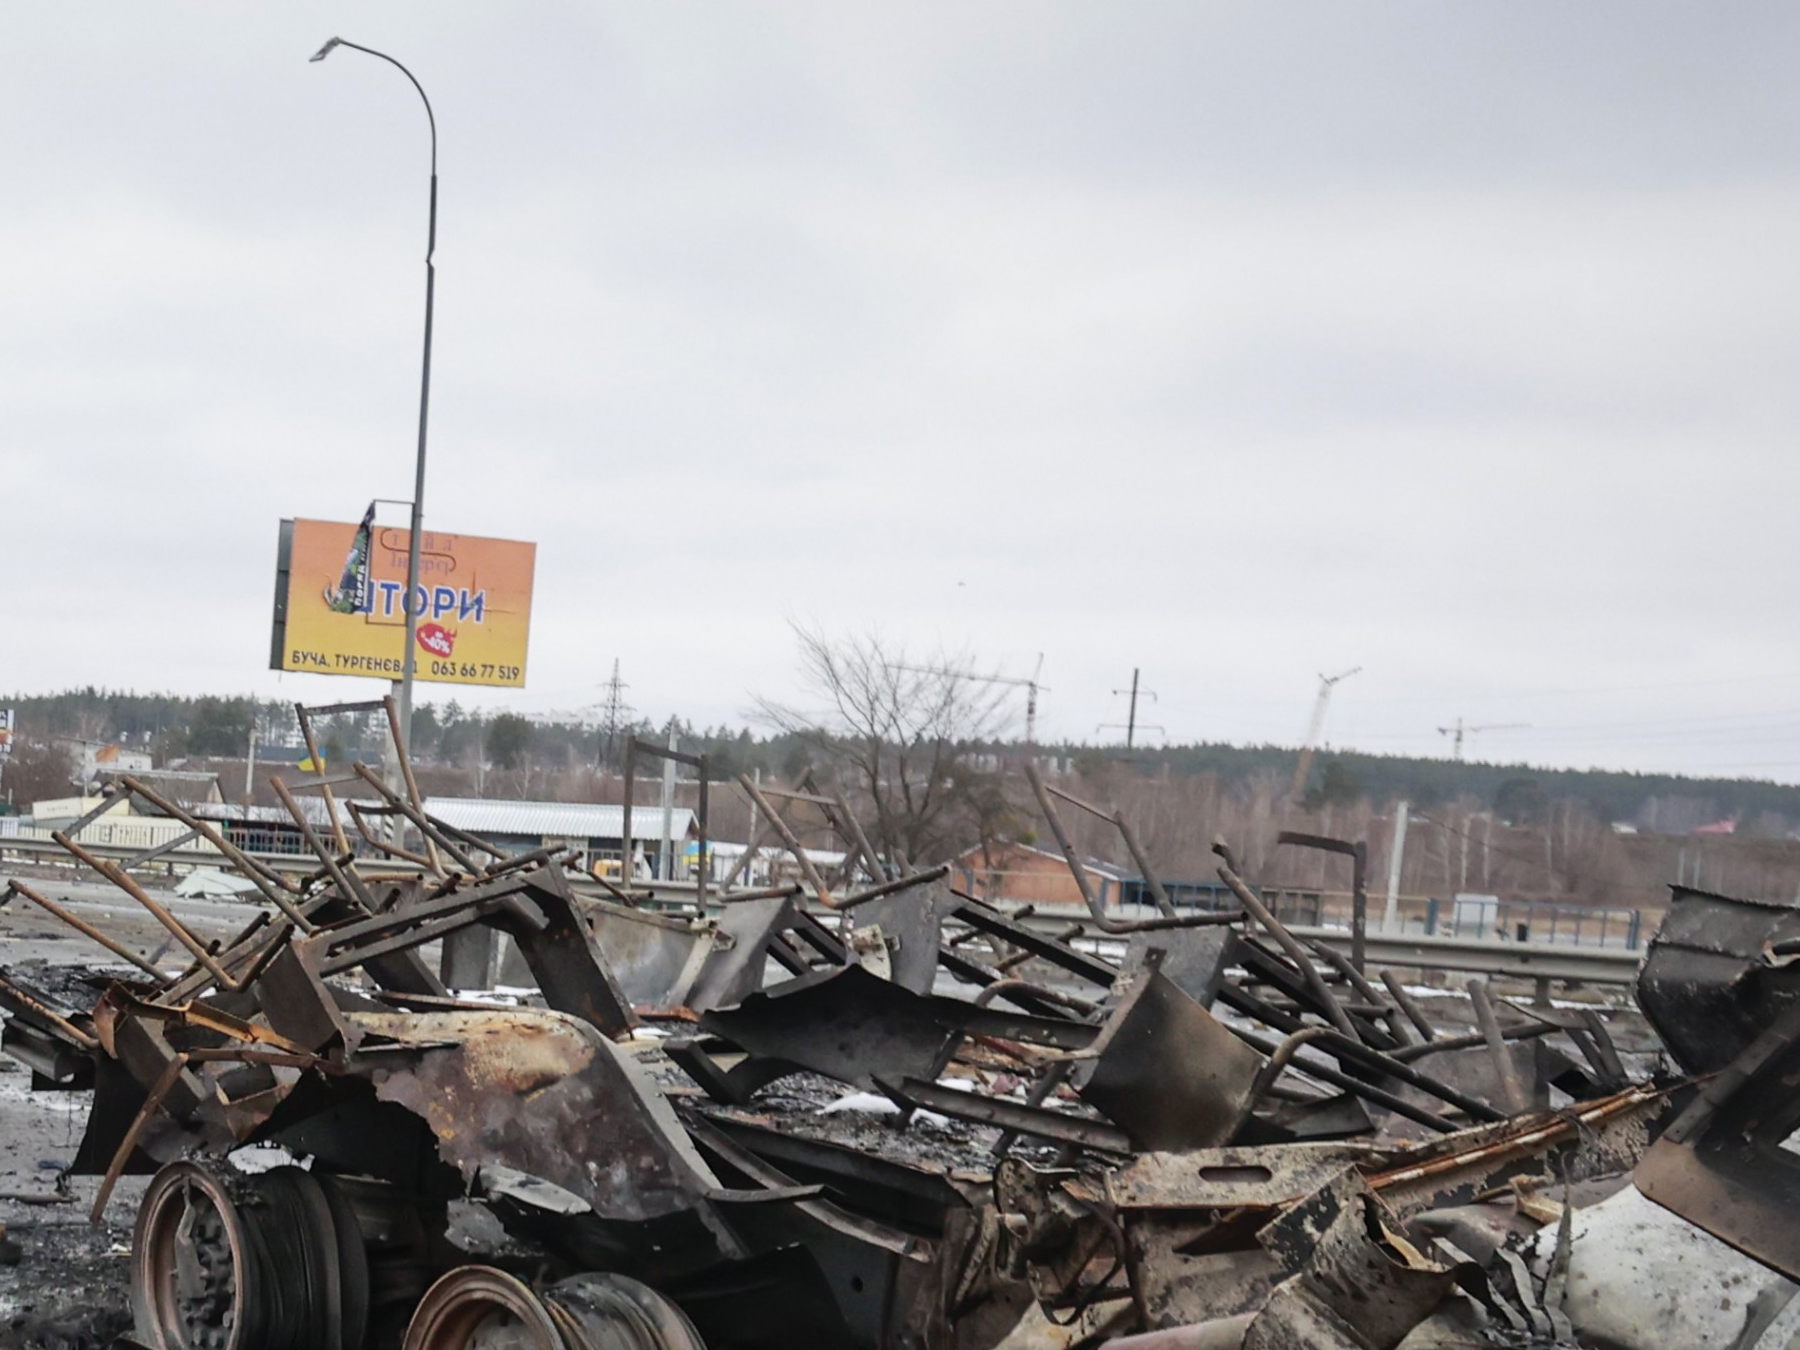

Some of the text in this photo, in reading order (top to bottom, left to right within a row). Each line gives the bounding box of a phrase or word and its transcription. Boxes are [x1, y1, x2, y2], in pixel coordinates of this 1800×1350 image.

[335, 654, 405, 674] ТУРГЕНЄВ
[431, 661, 520, 681] 063 66 77 519
